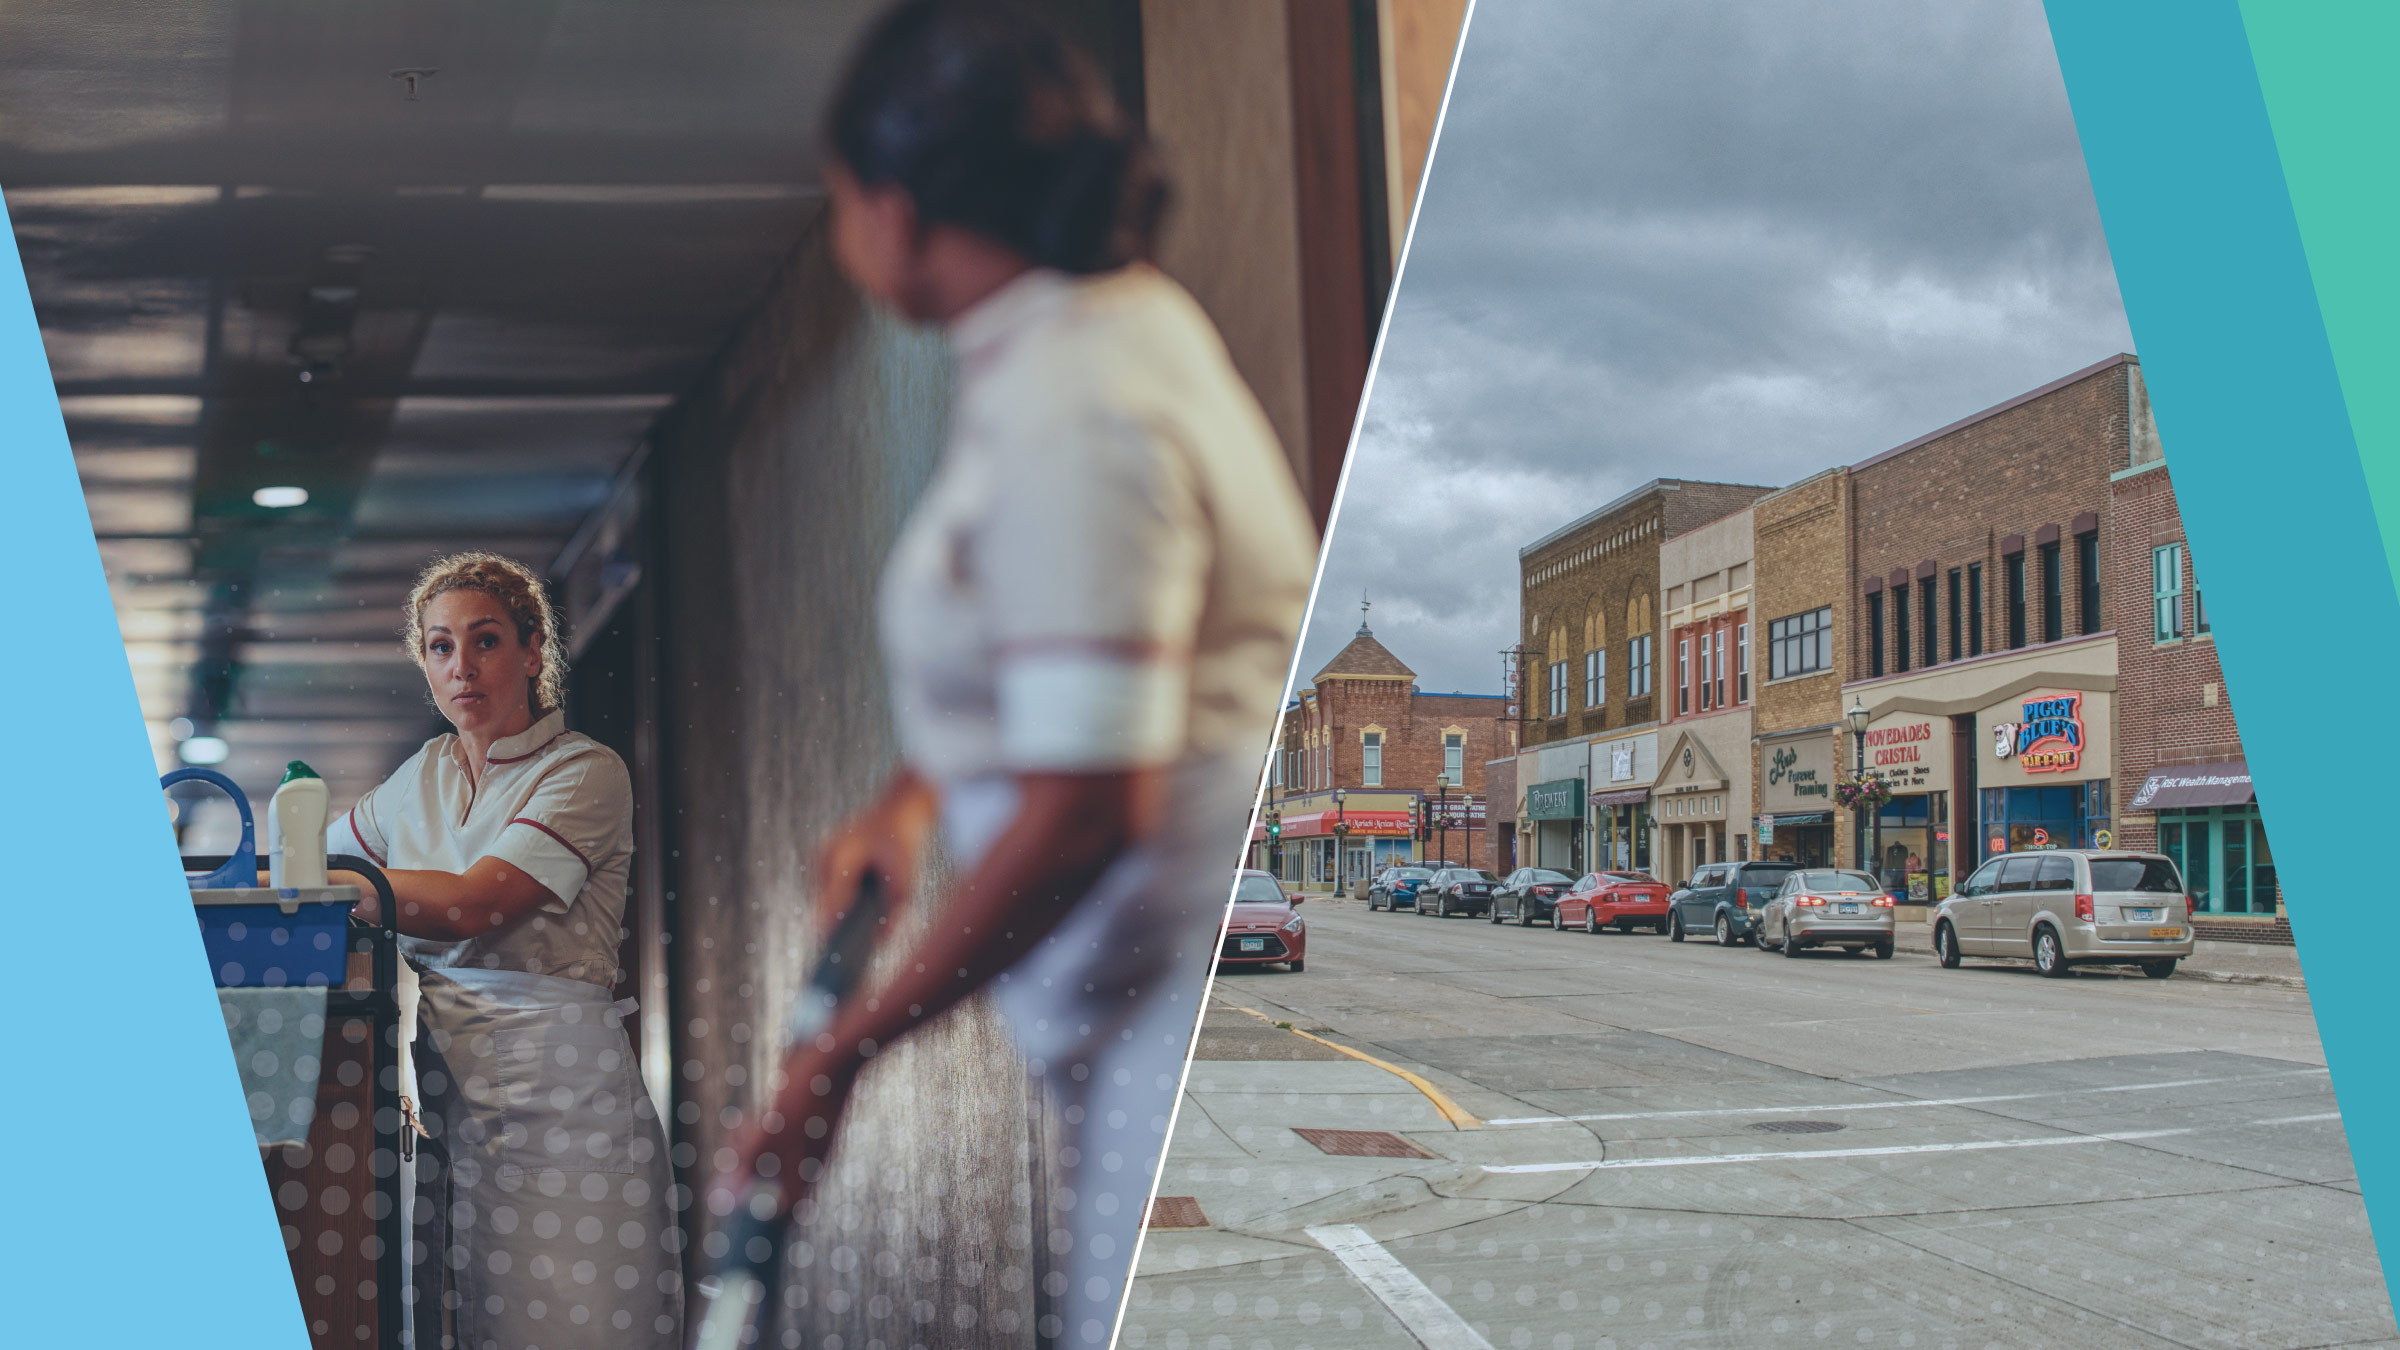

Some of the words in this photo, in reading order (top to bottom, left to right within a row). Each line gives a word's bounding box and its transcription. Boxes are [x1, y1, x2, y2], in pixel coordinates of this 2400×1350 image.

[2023, 697, 2074, 723] PIGGY
[1865, 722, 1931, 748] NOVEDADES
[2020, 719, 2078, 752] BLUE'S
[1875, 745, 1920, 766] CRISTAL
[2023, 752, 2073, 769] BAR-B-QUE
[1787, 769, 1816, 783] Forever
[1889, 768, 1908, 777] Clothes
[1913, 766, 1929, 775] Shoes
[1794, 780, 1828, 798] Framing
[1911, 777, 1924, 785] More
[2161, 778, 2179, 788] RBC
[2178, 775, 2206, 787] Wealth
